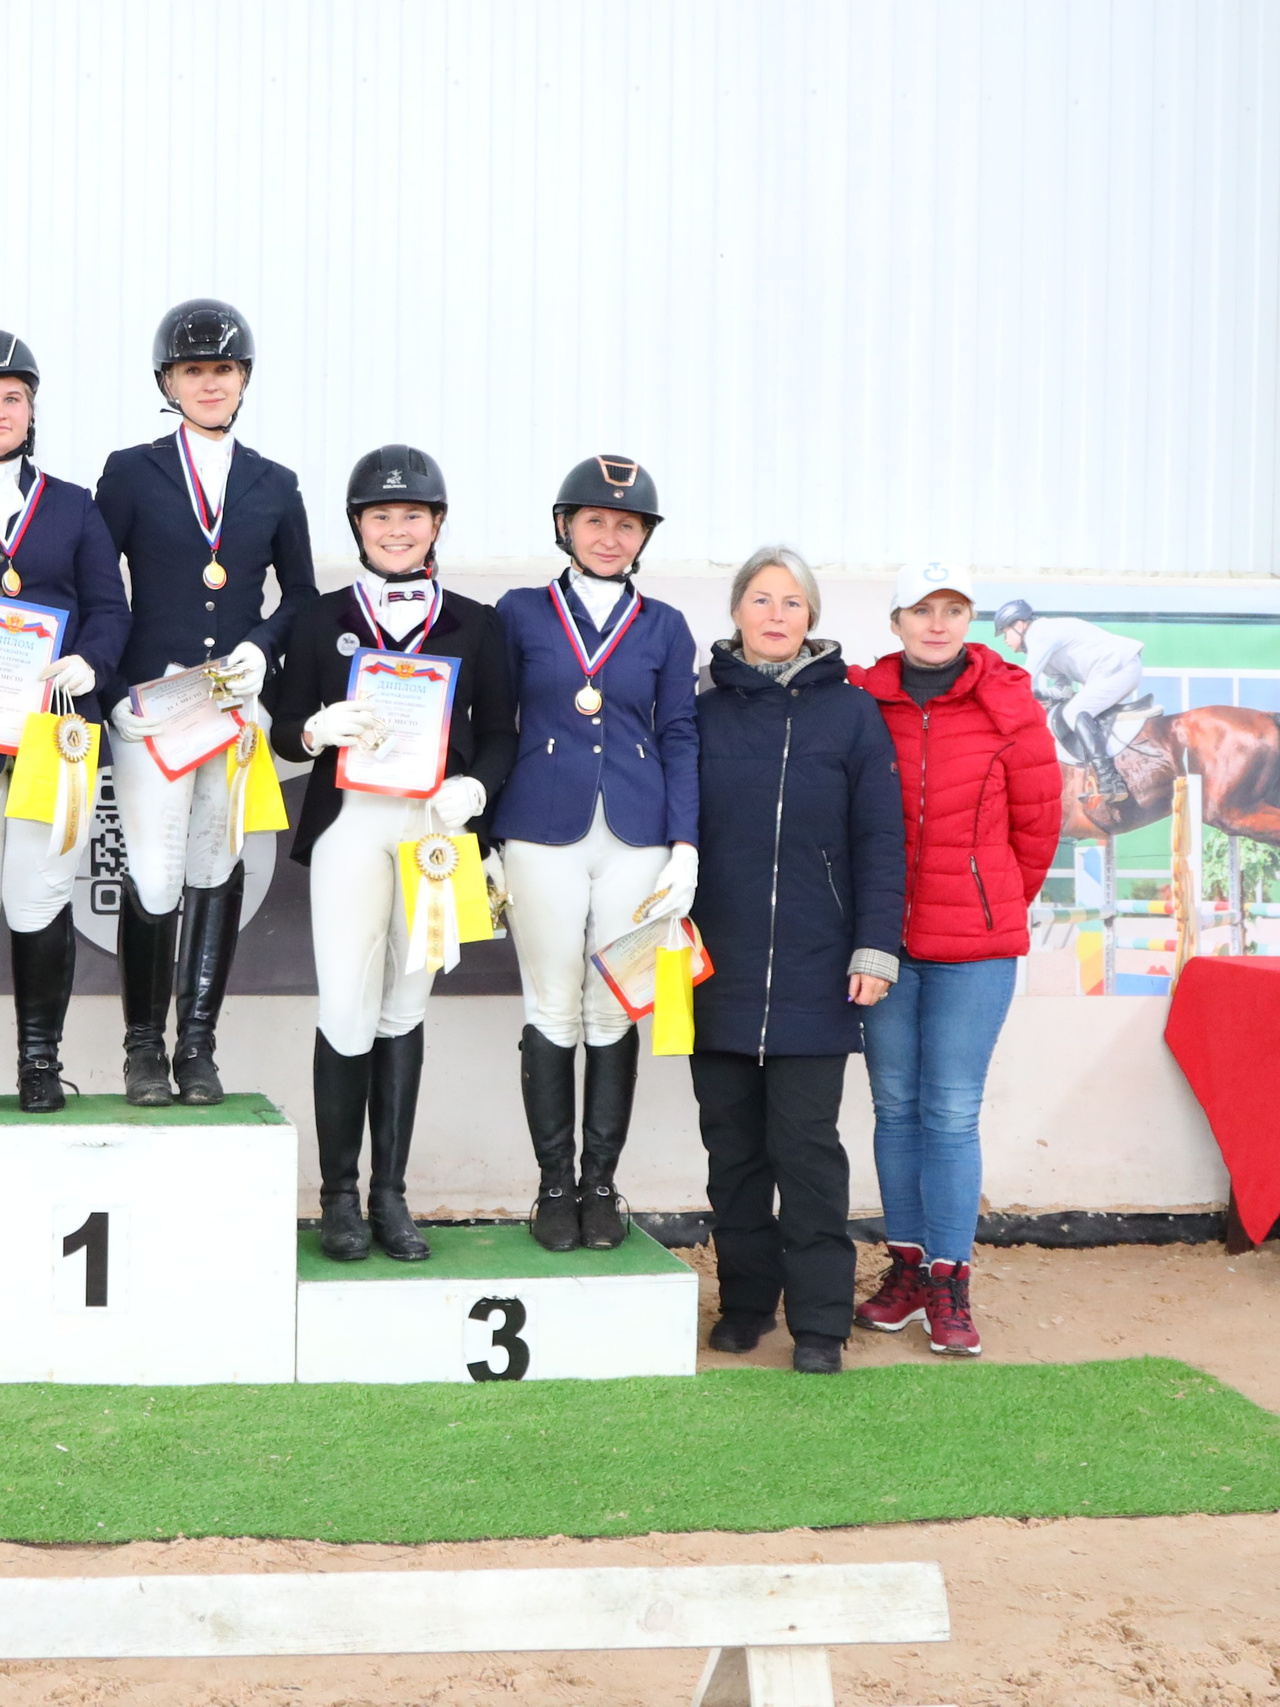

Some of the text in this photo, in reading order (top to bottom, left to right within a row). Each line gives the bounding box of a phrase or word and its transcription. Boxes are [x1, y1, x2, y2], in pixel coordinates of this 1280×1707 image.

[376, 680, 427, 693] ДИПЛОМ
[395, 719, 418, 727] МЕСТО
[63, 1213, 108, 1306] 1
[467, 1297, 531, 1382] 3
